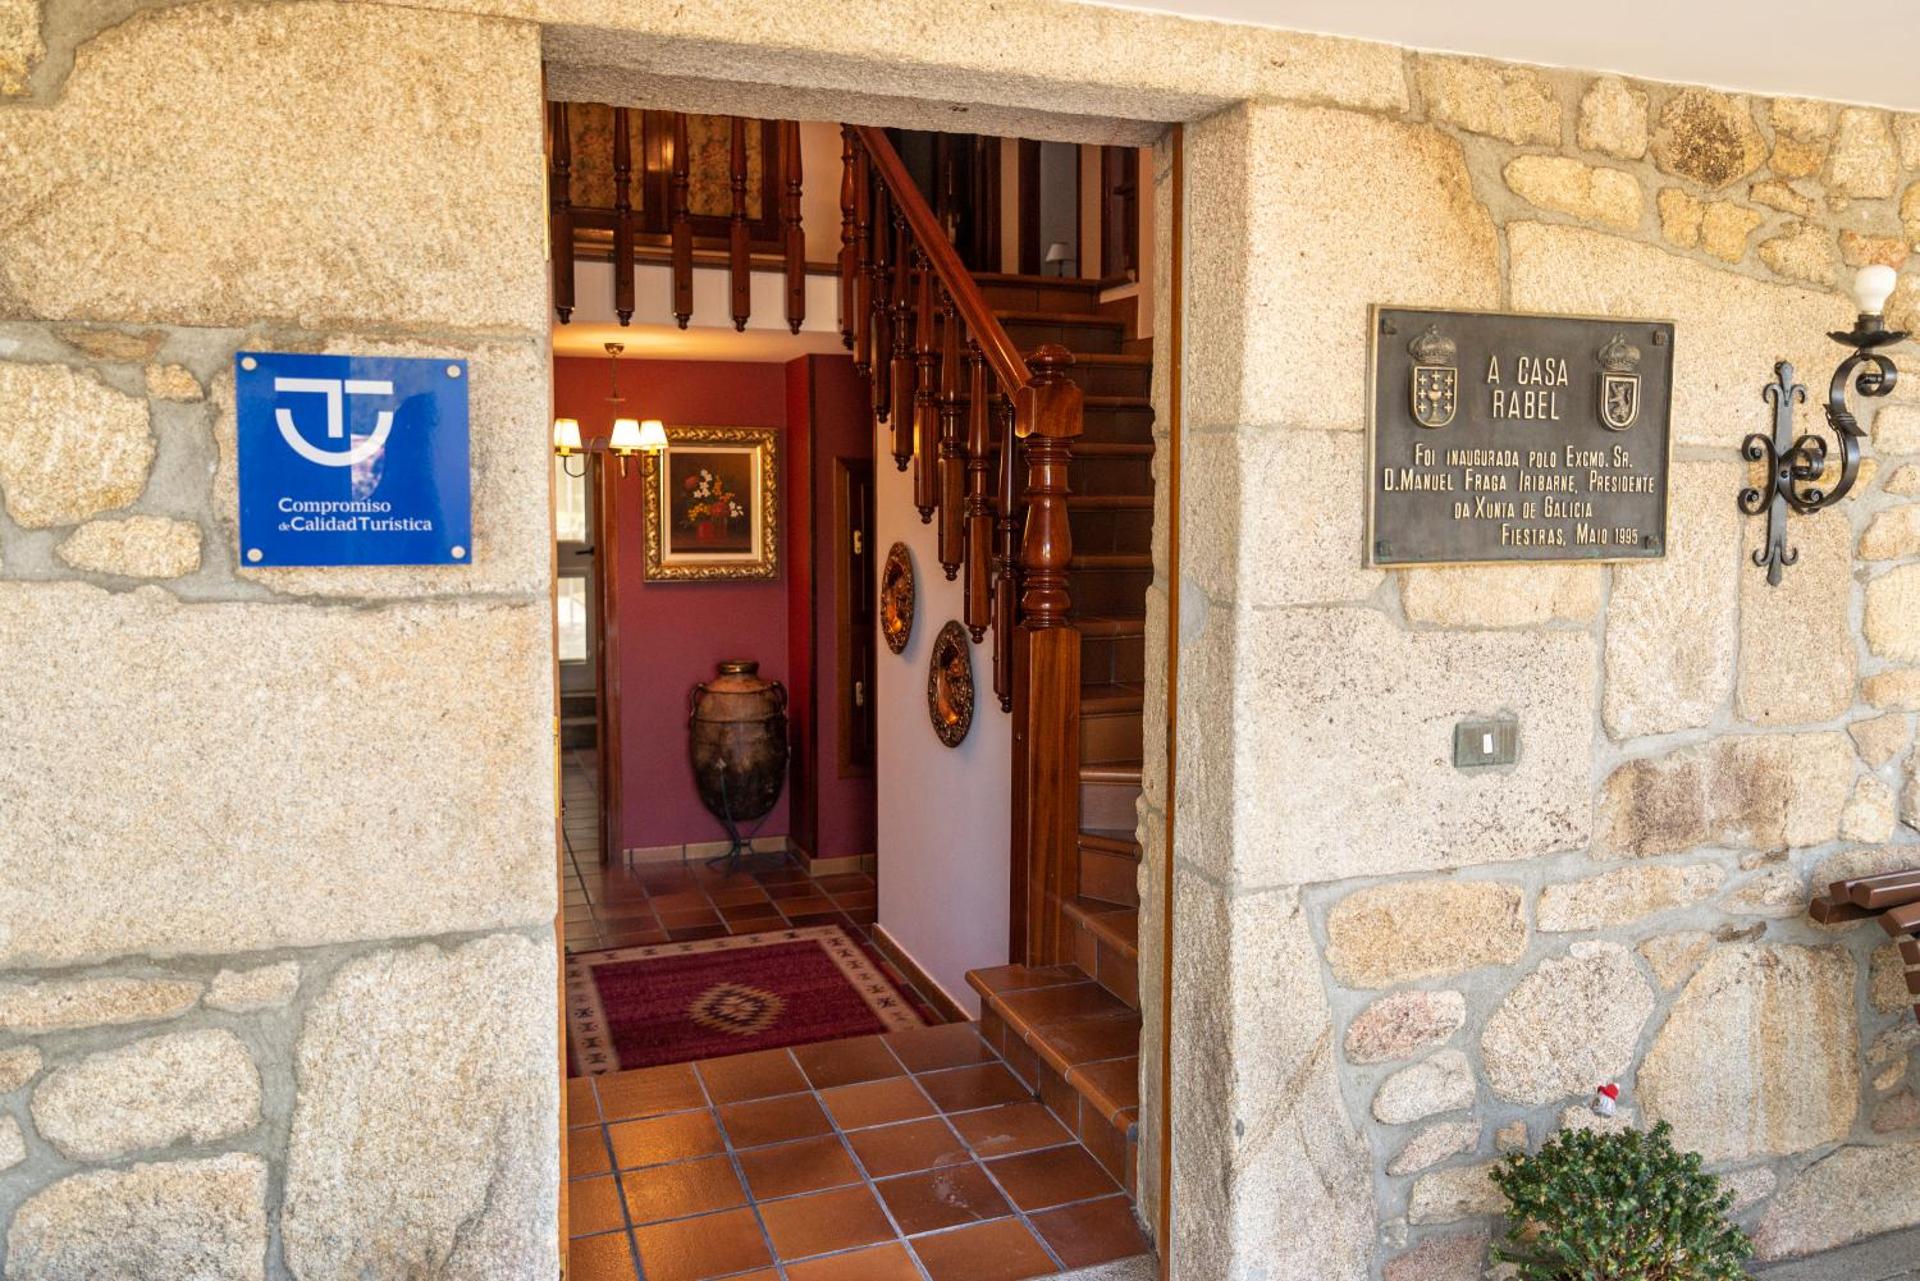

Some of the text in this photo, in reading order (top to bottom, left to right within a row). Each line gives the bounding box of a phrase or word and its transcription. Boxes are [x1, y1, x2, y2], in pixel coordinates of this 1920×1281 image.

[1487, 355, 1568, 386] A CASA
[1492, 390, 1560, 420] RABEL
[1415, 444, 1435, 466] FOI
[1529, 450, 1556, 468] POLO
[1613, 446, 1632, 468] SR.
[1465, 468, 1506, 491] FRAGA
[1589, 471, 1655, 493] PRESIDENTE
[278, 498, 391, 516] Compromiso
[1454, 496, 1592, 519] DA XUNTA DE GALICIA
[291, 517, 357, 531] Calidad
[359, 517, 432, 531] Turística
[1502, 523, 1638, 547] FIESTRAS, MAIO 1995
